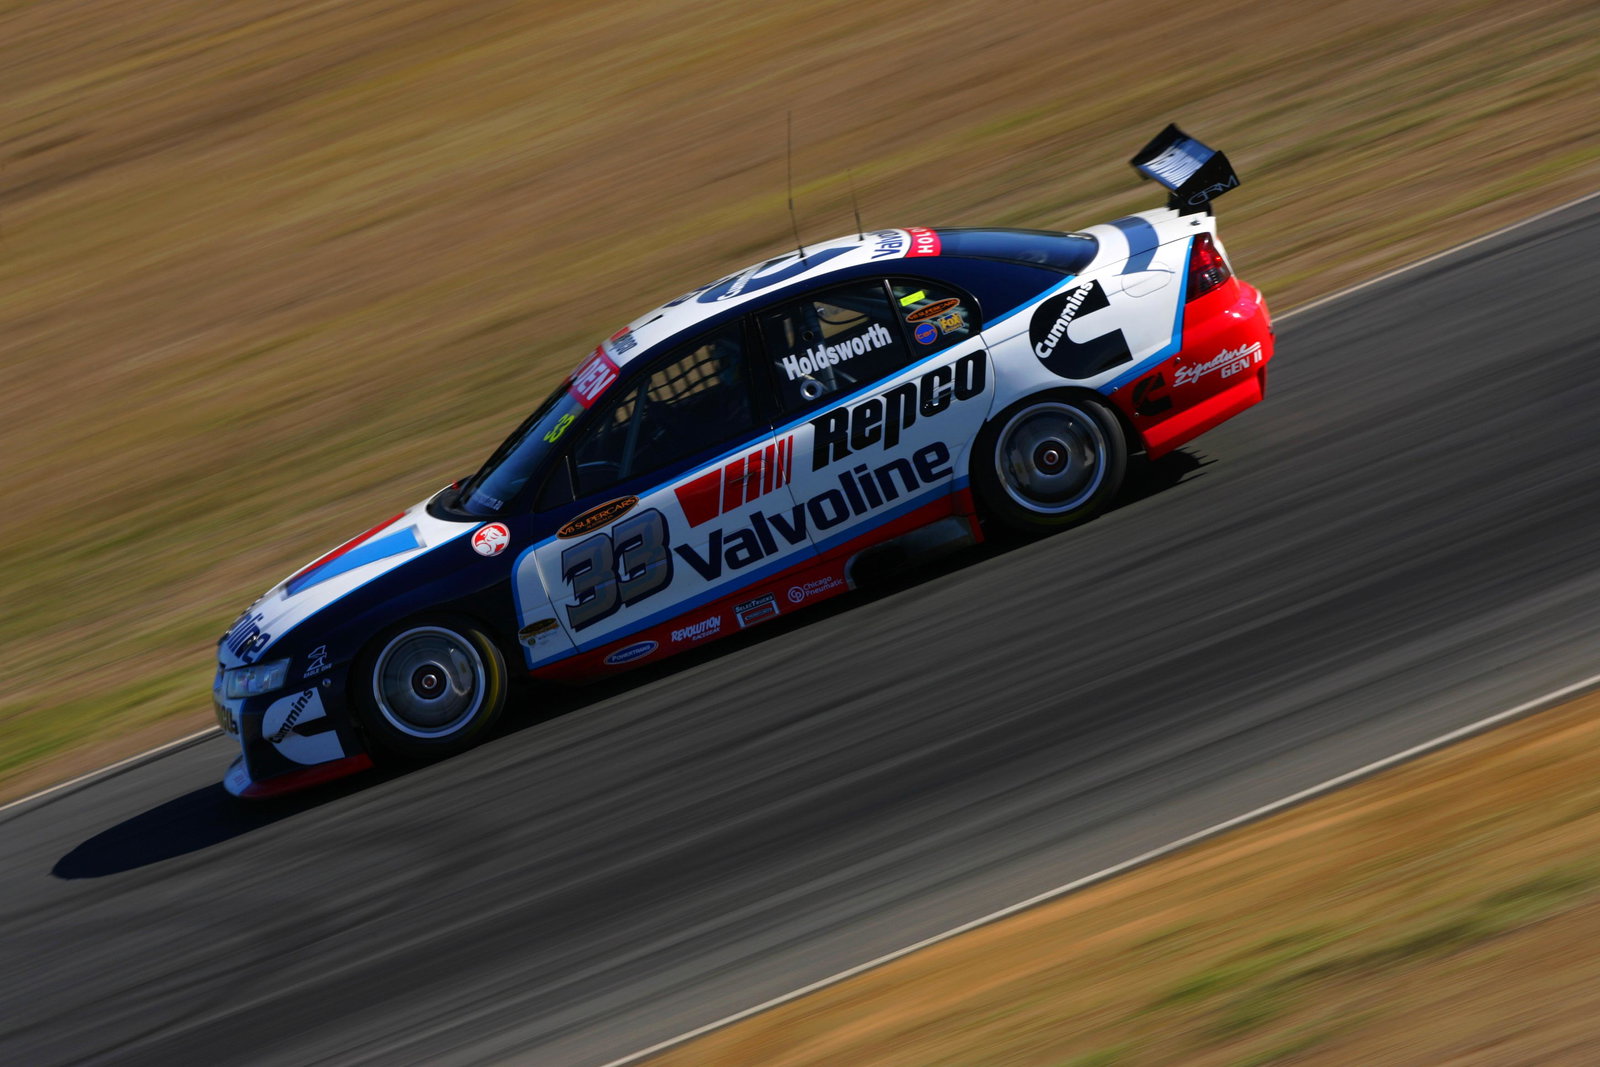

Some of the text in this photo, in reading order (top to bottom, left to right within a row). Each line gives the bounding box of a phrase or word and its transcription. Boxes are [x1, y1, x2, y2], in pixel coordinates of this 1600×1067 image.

[1035, 279, 1094, 359] Cummins
[782, 322, 893, 381] Holdsworth
[1173, 342, 1262, 387] Signature
[1221, 357, 1250, 379] GEN
[543, 413, 575, 443] 33
[807, 349, 987, 472] Repco
[573, 498, 636, 530] SUPERCARS
[673, 441, 954, 582] Valvoline
[562, 507, 674, 633] 33
[803, 575, 844, 598] Chicago Pneumatic
[671, 615, 721, 643] REVOLUTION
[268, 687, 314, 744] Cummins
